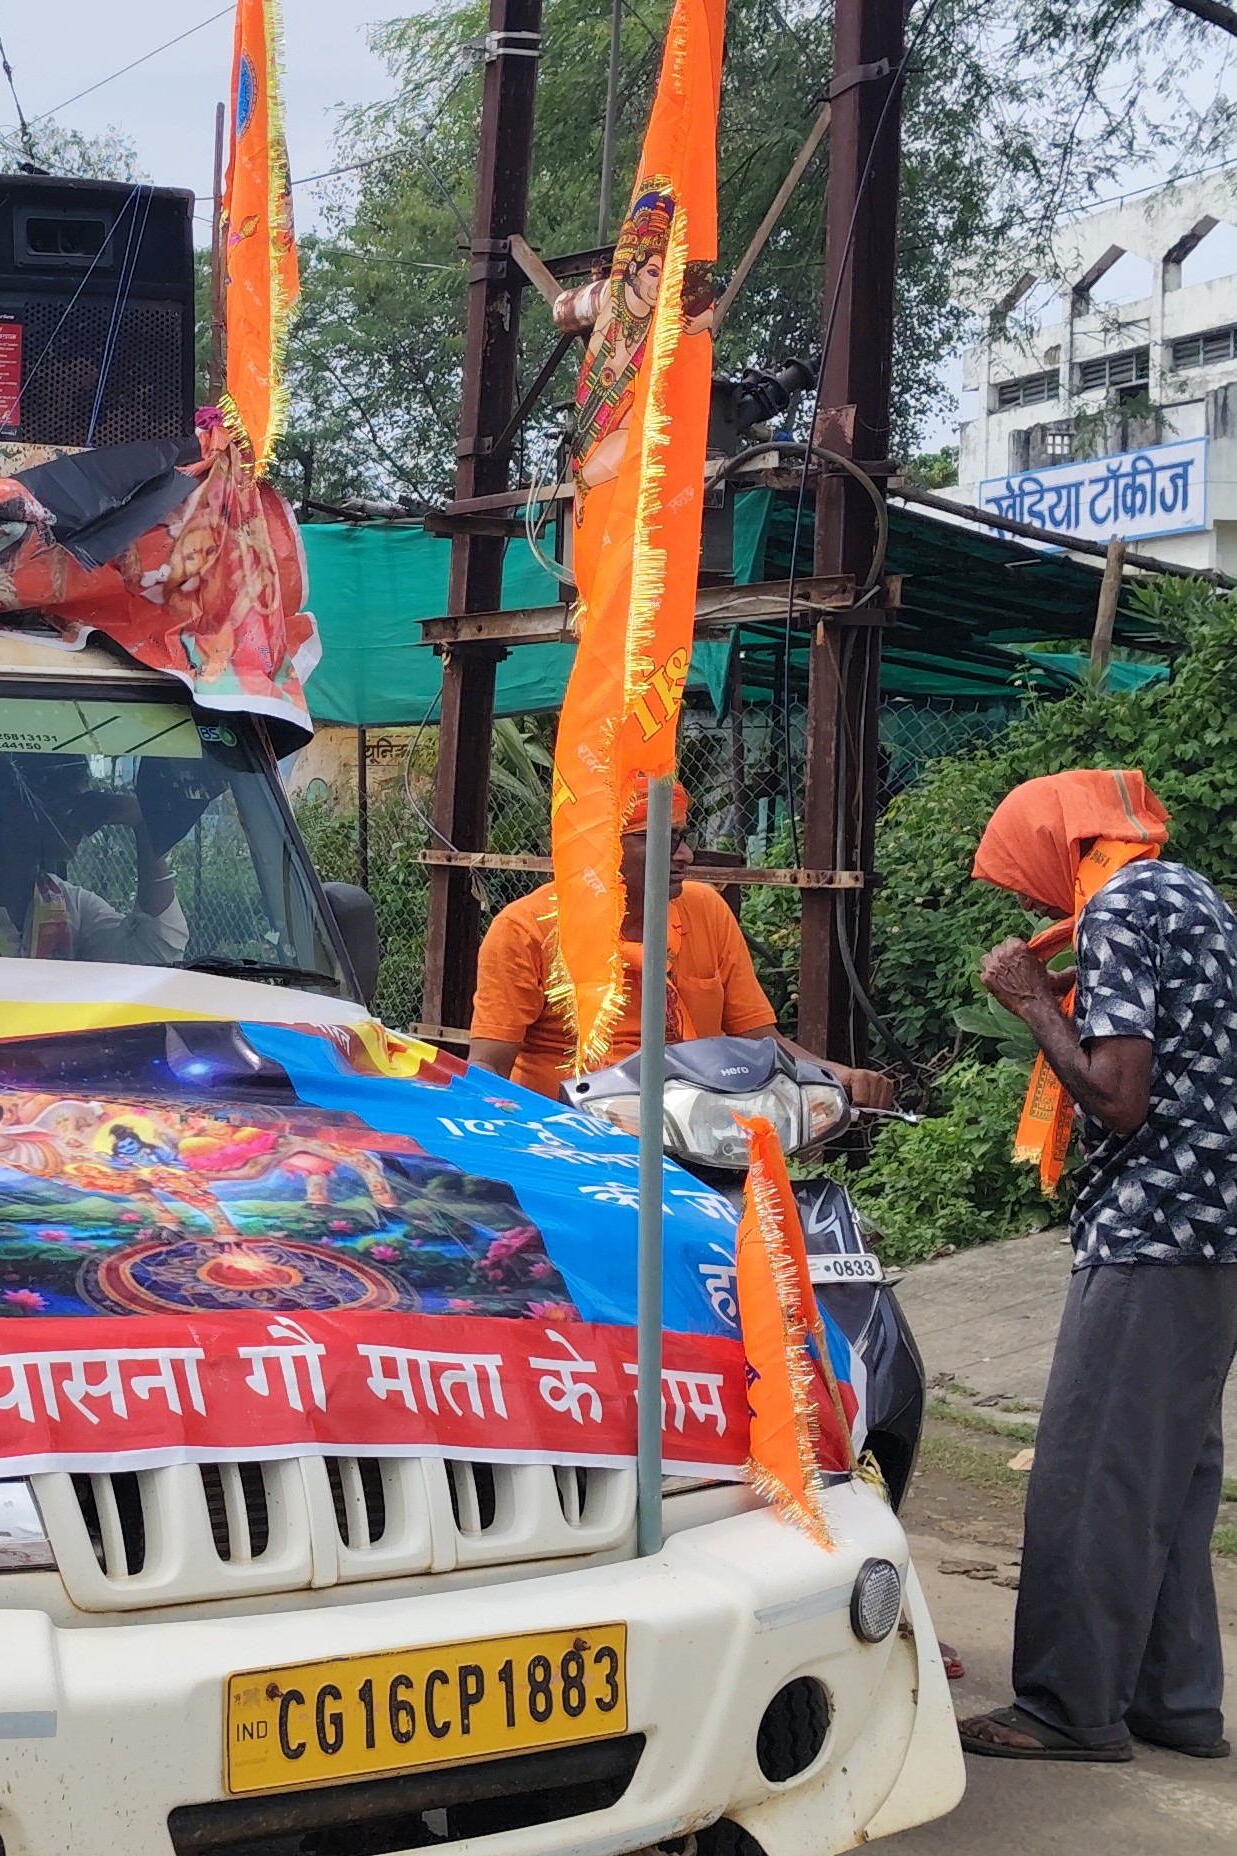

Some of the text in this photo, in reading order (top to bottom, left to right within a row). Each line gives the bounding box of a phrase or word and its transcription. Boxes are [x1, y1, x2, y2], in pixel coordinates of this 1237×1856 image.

[1089, 455, 1196, 529] टॉकीज
[720, 1065, 750, 1077] Hero
[832, 1259, 877, 1277] 0833
[237, 1317, 327, 1414] गौ
[358, 1343, 509, 1421] माता
[530, 1328, 603, 1426] के
[623, 1362, 728, 1438] ाम
[277, 1645, 620, 1761] CG16CP1883
[236, 1720, 268, 1742] IND
